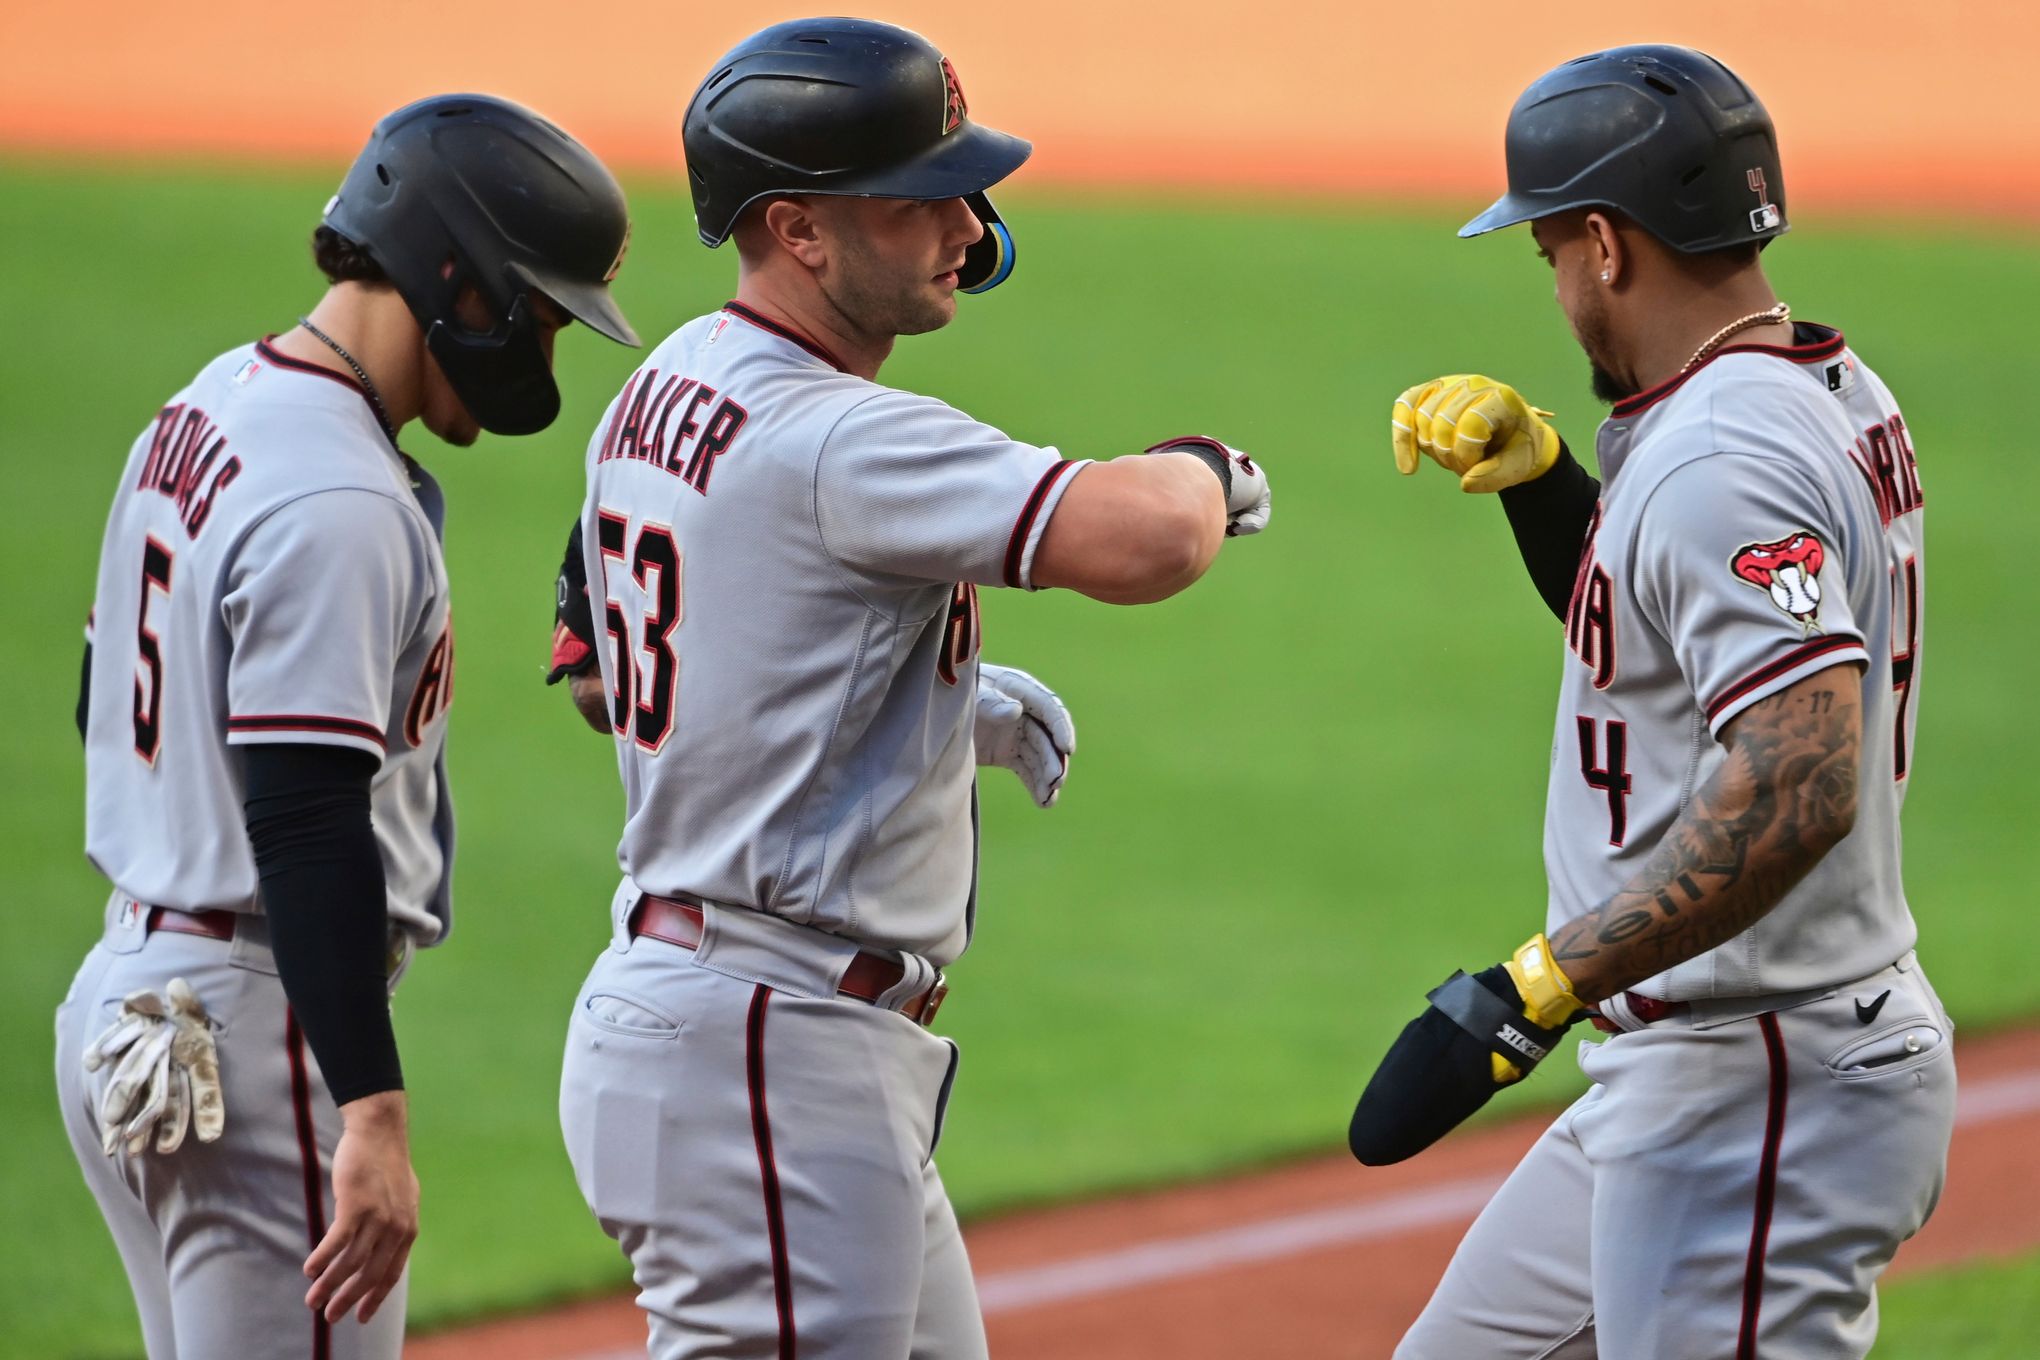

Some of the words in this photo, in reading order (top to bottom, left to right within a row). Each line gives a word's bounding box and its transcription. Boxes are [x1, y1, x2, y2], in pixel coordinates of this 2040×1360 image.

[1746, 167, 1768, 207] 4
[133, 532, 173, 770] 5
[598, 503, 684, 757] 53
[1576, 714, 1632, 848] 4
